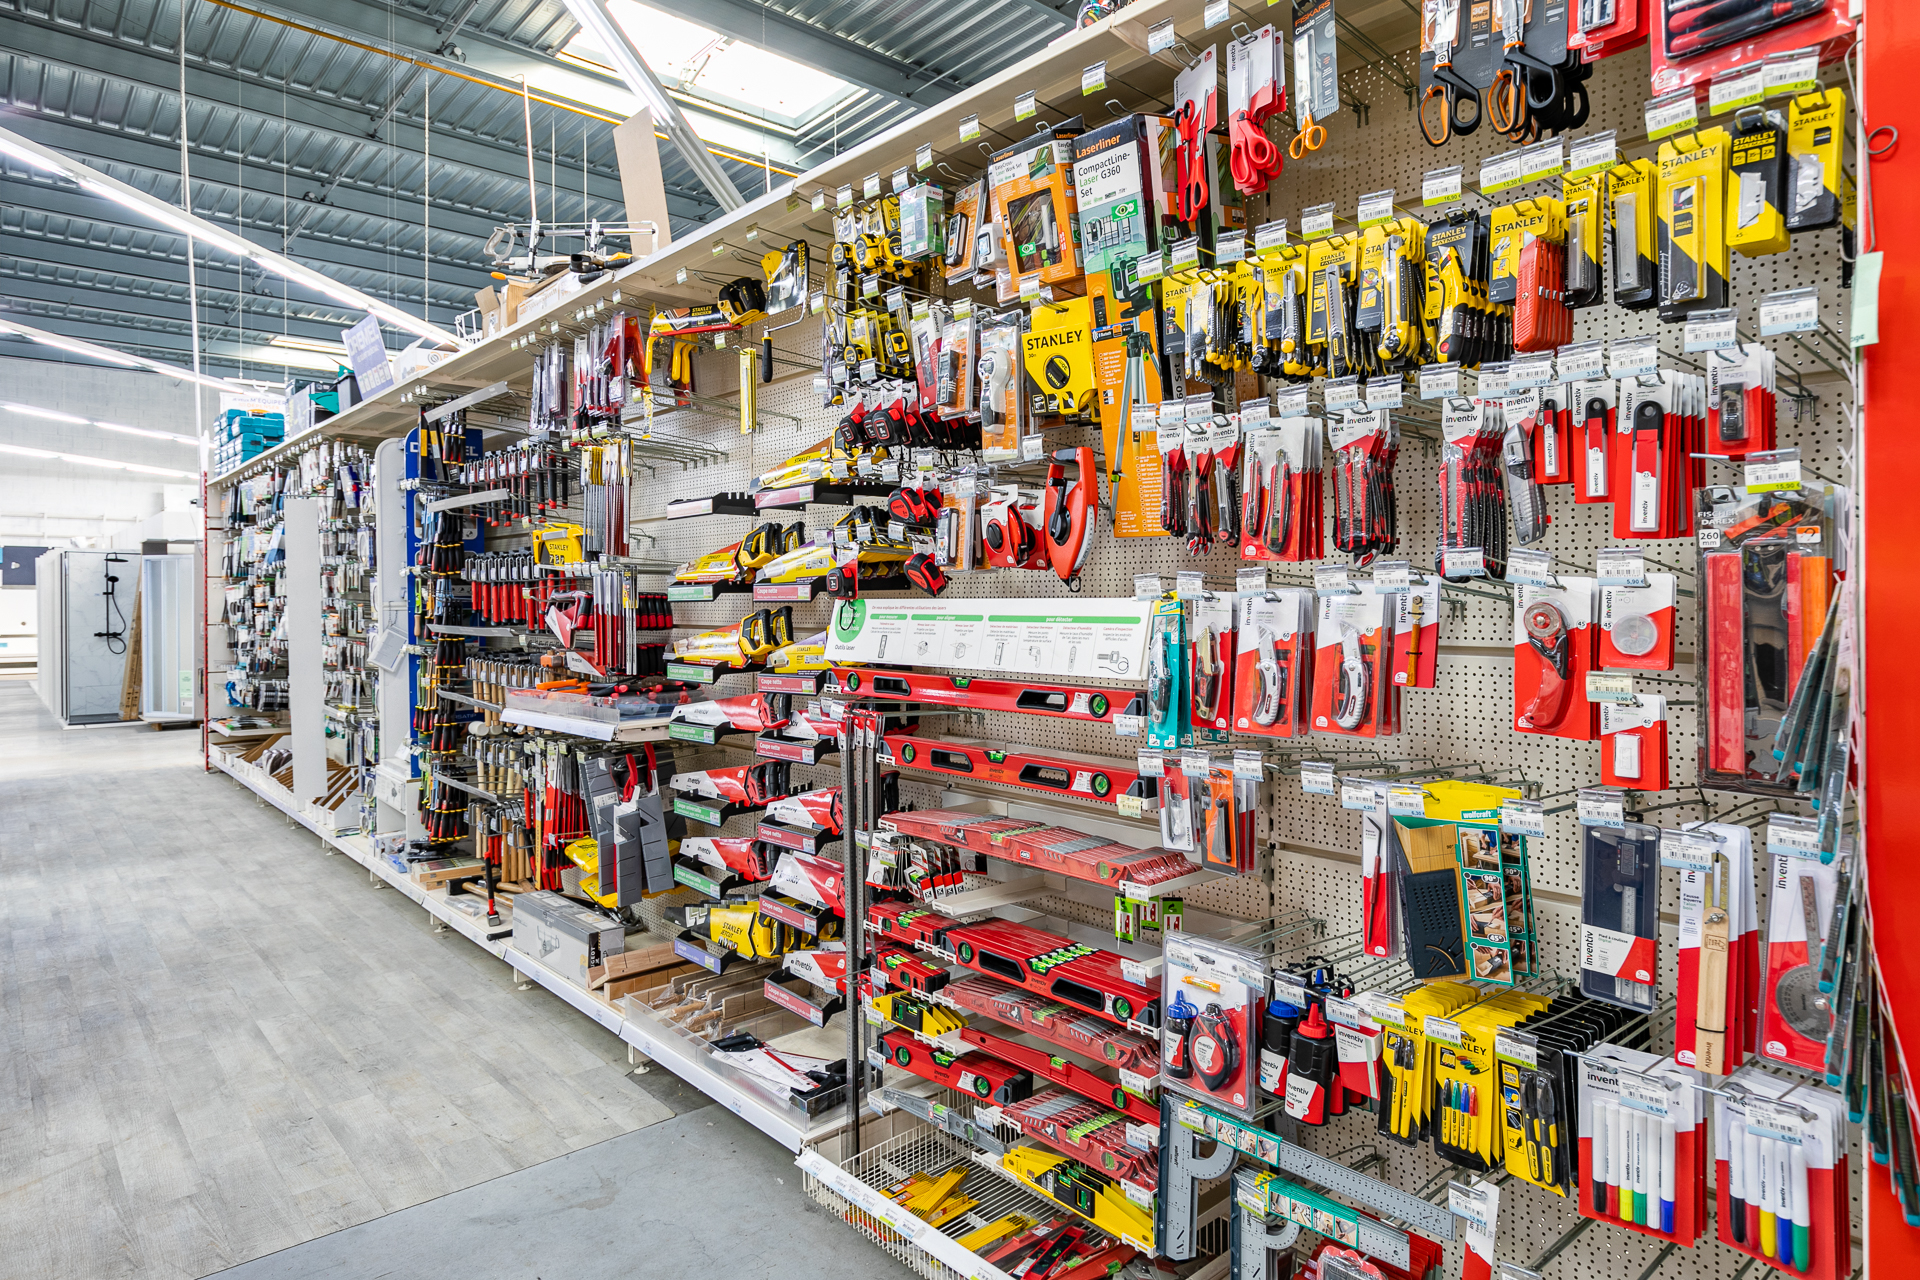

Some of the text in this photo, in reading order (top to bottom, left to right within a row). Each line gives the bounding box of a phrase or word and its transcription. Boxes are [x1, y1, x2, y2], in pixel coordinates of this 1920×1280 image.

[1295, 0, 1331, 27] FISKARS
[1472, 4, 1489, 14] 30%
[1295, 18, 1315, 35] Classic
[1674, 121, 1691, 130] 15,50
[1793, 111, 1835, 128] STANLEY
[1733, 130, 1776, 146] STANLEY
[1076, 134, 1121, 158] Laserliner
[993, 150, 1014, 163] Laserliner
[1661, 146, 1718, 171] STANLEY
[1078, 153, 1130, 176] CompactLine-
[1079, 165, 1121, 187] Laser G360
[1611, 176, 1646, 190] STANLEY
[1080, 187, 1093, 198] Set
[1565, 182, 1596, 197] STANLEY
[1494, 215, 1544, 234] STANLEY
[1432, 226, 1467, 242] STANLEY
[1320, 251, 1346, 262] STANLEY
[1267, 264, 1293, 275] STANLEY
[692, 306, 712, 314] STANLEY
[1026, 330, 1083, 350] STANLEY
[1506, 394, 1535, 407] inventiv
[1624, 392, 1632, 421] inventiv
[1346, 416, 1376, 426] inventiv
[1445, 413, 1478, 424] inventiv
[1213, 428, 1236, 437] inventiv
[1468, 427, 1476, 435] 25
[1186, 434, 1210, 444] inventiv
[1698, 510, 1738, 518] FISCHER
[1701, 517, 1735, 525] DAREX
[1700, 532, 1719, 540] 260
[687, 804, 701, 814] universelle
[1462, 810, 1493, 819] wolfcraft
[697, 845, 711, 855] inventiv
[676, 869, 701, 884] Coupe universelle
[1484, 874, 1497, 882] 90°
[761, 900, 783, 914] Coupe nette
[720, 930, 734, 939] JETCUT
[722, 922, 743, 936] STANLEY
[1490, 934, 1504, 942] 45°
[677, 942, 687, 950] Coupe
[1585, 930, 1594, 965] inventiv
[793, 957, 812, 972] inventiv
[1031, 978, 1047, 987] inventiv
[767, 985, 789, 1001] Coupe nette
[1338, 1030, 1364, 1044] inventiv
[1769, 1042, 1776, 1050] 5
[933, 1068, 950, 1080] inventiv
[1587, 1071, 1619, 1086] invent
[1287, 1082, 1309, 1096] inventiv
[1587, 1083, 1610, 1092] Marqueurs
[1646, 1105, 1662, 1114] 16,90
